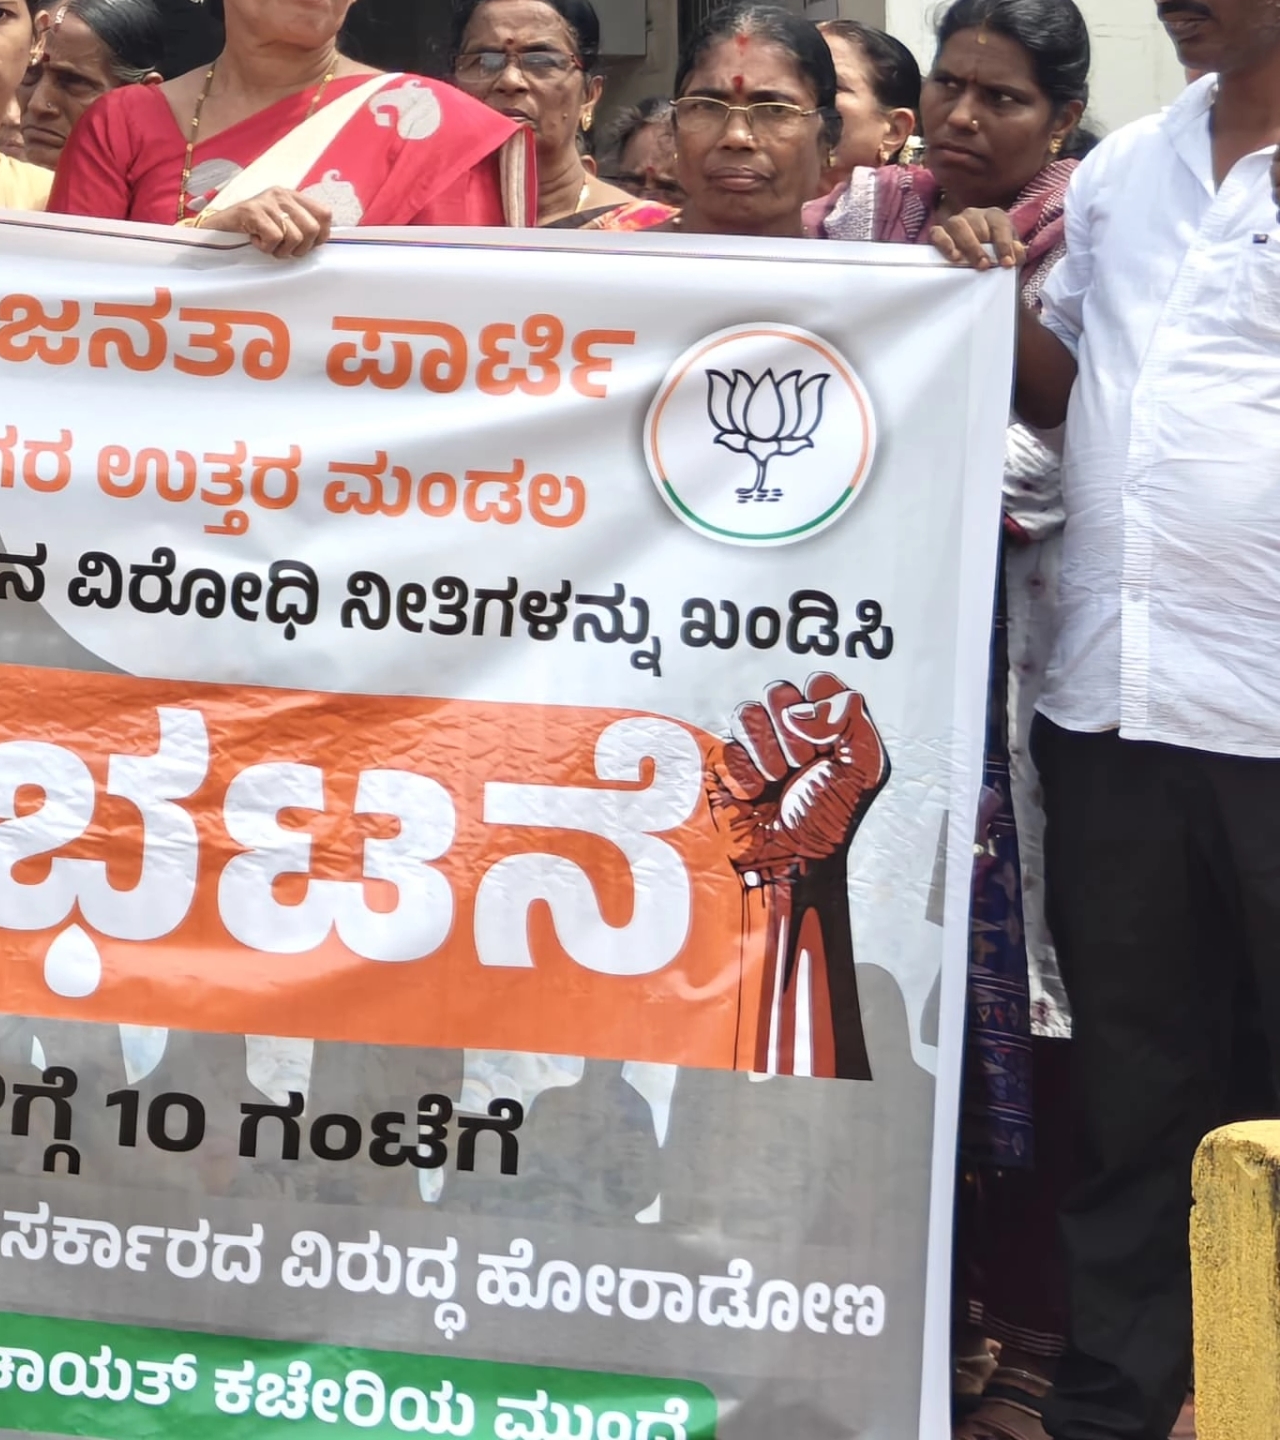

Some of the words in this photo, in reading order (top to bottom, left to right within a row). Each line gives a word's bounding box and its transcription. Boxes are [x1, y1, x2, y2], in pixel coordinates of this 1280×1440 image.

[325, 313, 636, 398] ಪಾರ್ಟಿ
[96, 440, 302, 537] ಉತ್ತರ
[323, 450, 587, 528] ಮಂಡಲ
[66, 546, 321, 641] ವಿರೋಧಿ
[339, 569, 662, 677] ನೀತಿಗಳನ್ನು
[679, 589, 896, 661] ಖಂಡಿಸಿ
[105, 1088, 207, 1153] 10
[238, 1090, 525, 1176] ಗಂಟೆಗೆ
[0, 1201, 265, 1285] ಸರ್ಕಾರದ
[281, 1228, 468, 1341] ವಿರುದ್ಧ
[476, 1237, 886, 1338] ಹೋರಾಡೋಣ
[213, 1359, 475, 1437] ಕಚೇರಿಯ
